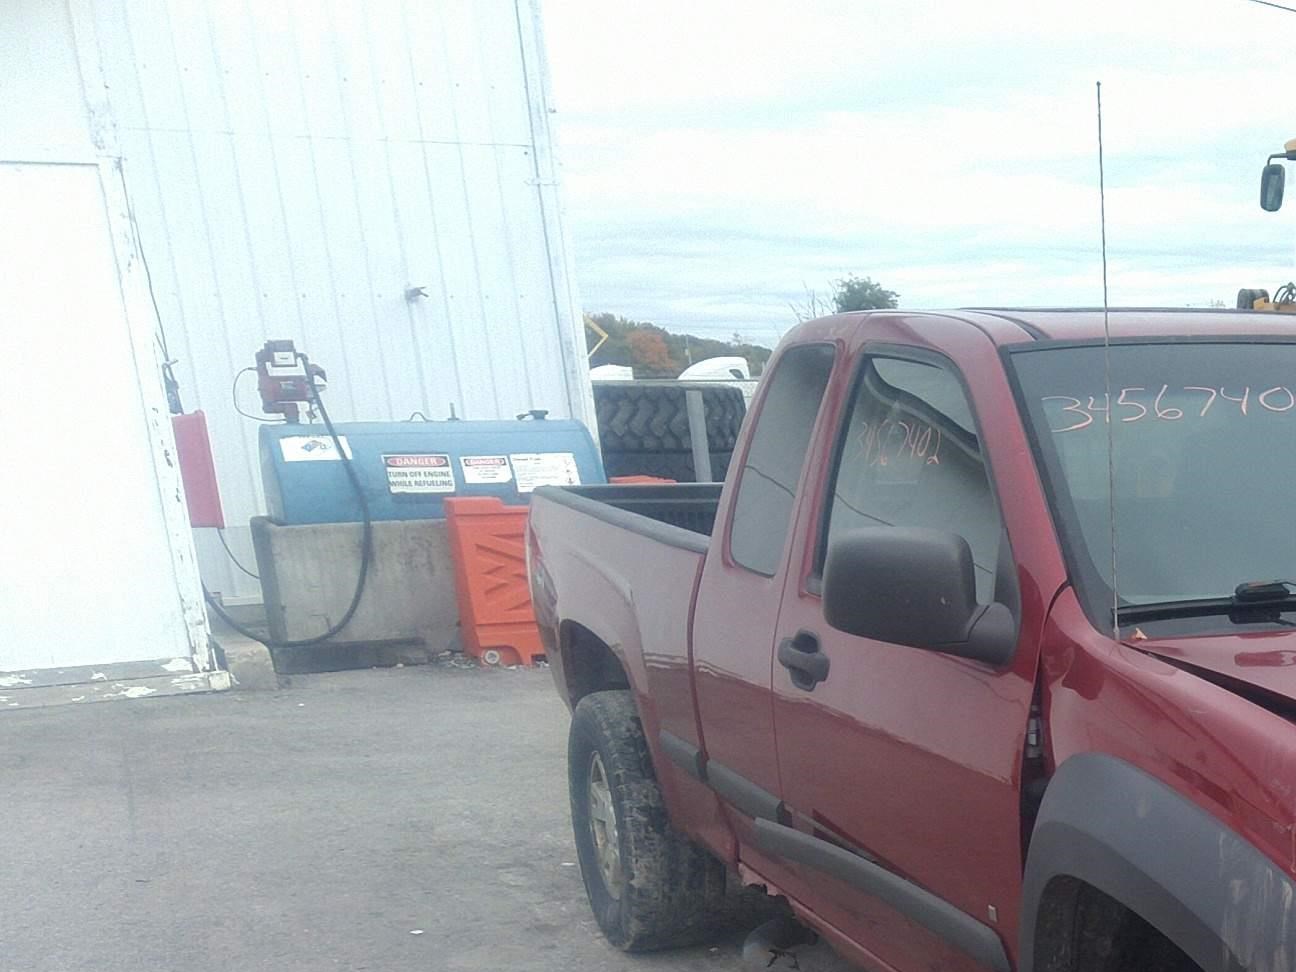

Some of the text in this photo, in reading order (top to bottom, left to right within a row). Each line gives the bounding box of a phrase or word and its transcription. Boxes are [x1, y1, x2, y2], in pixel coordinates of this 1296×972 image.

[396, 456, 438, 466] DANGER
[388, 470, 408, 479] TURN
[423, 470, 451, 478] ENGINE
[389, 479, 453, 488] WHILE REFUELING
